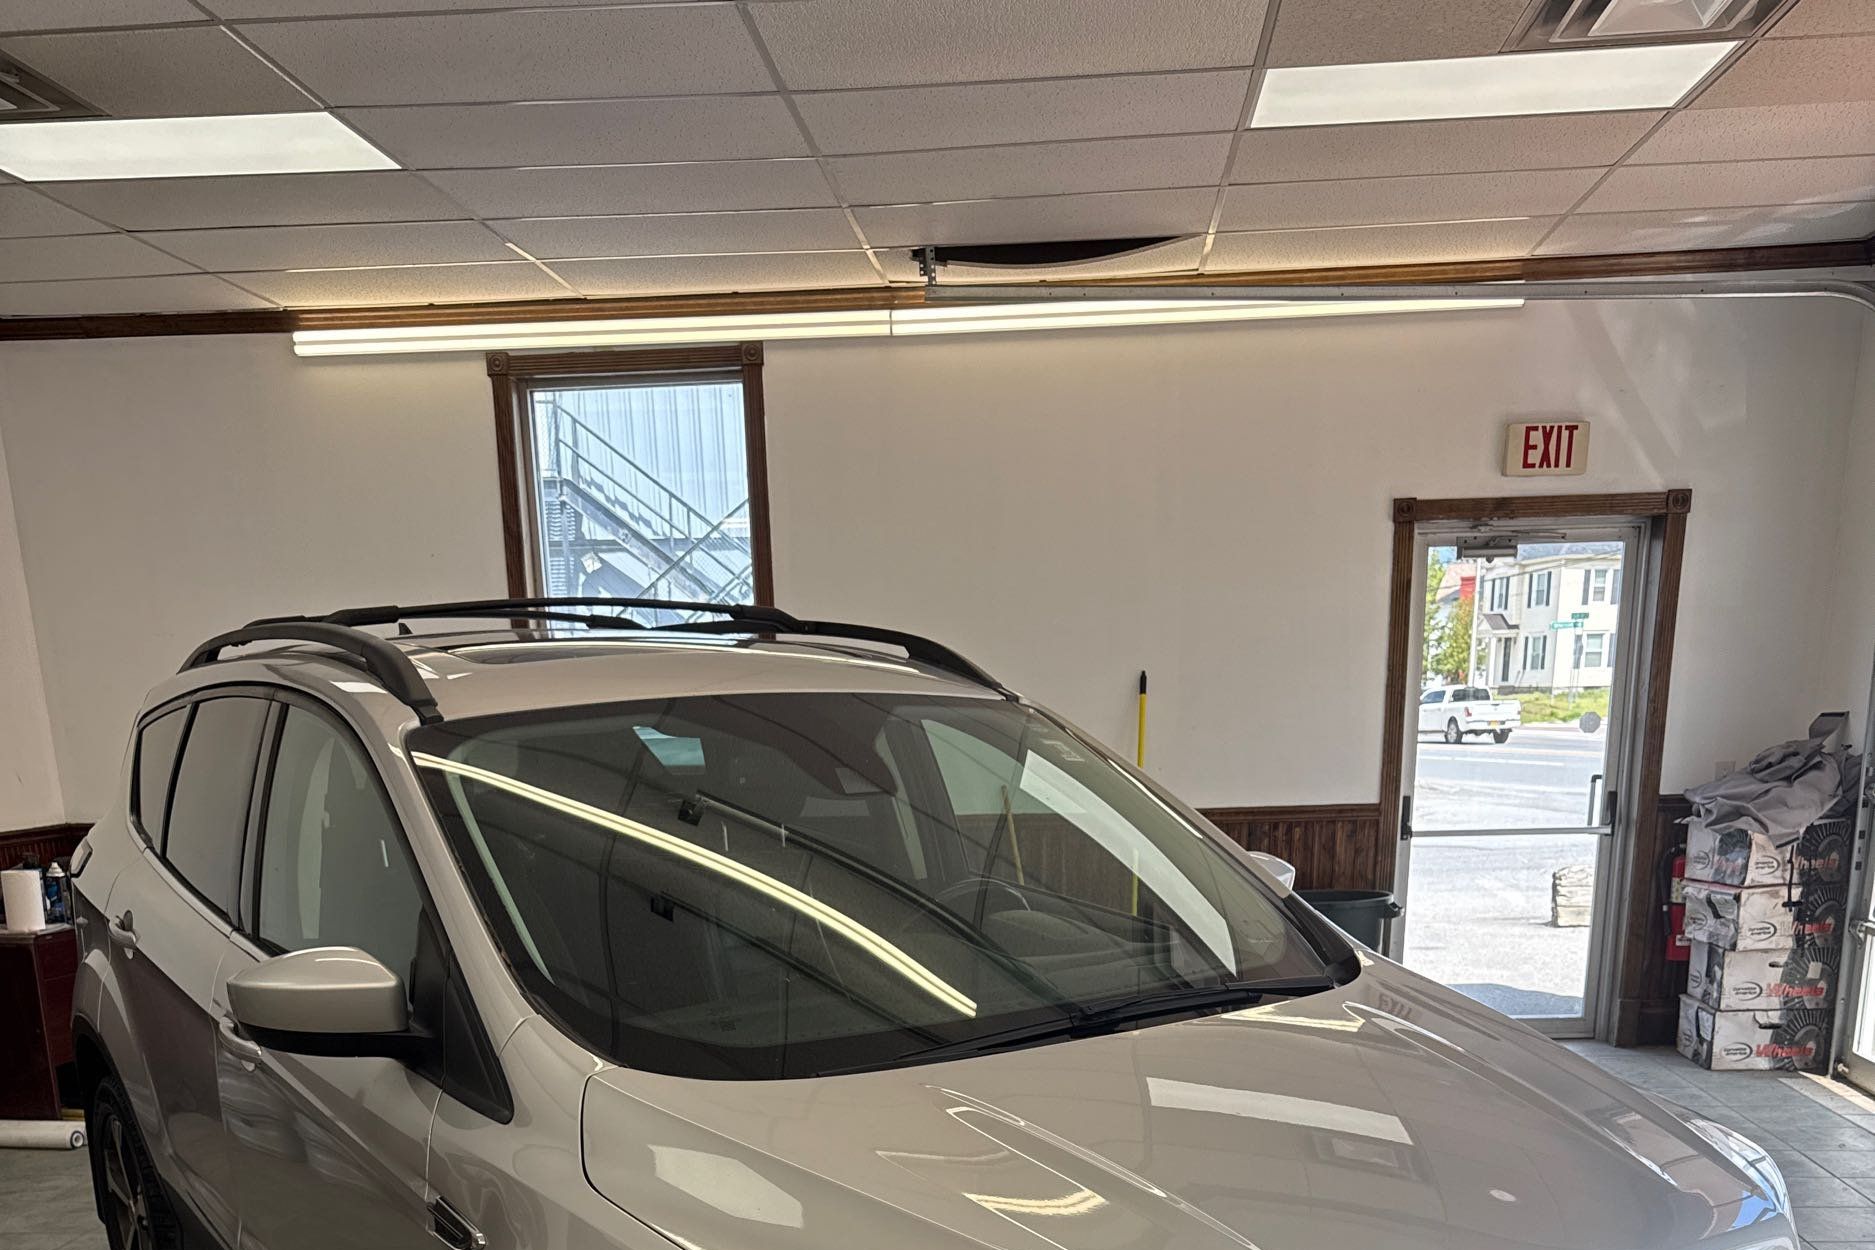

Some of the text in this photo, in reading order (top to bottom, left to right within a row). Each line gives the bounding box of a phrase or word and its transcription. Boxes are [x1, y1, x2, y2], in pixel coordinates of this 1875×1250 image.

[1522, 424, 1579, 469] EXIT
[1766, 983, 1825, 997] Wheels
[1755, 1043, 1813, 1058] Wheels
